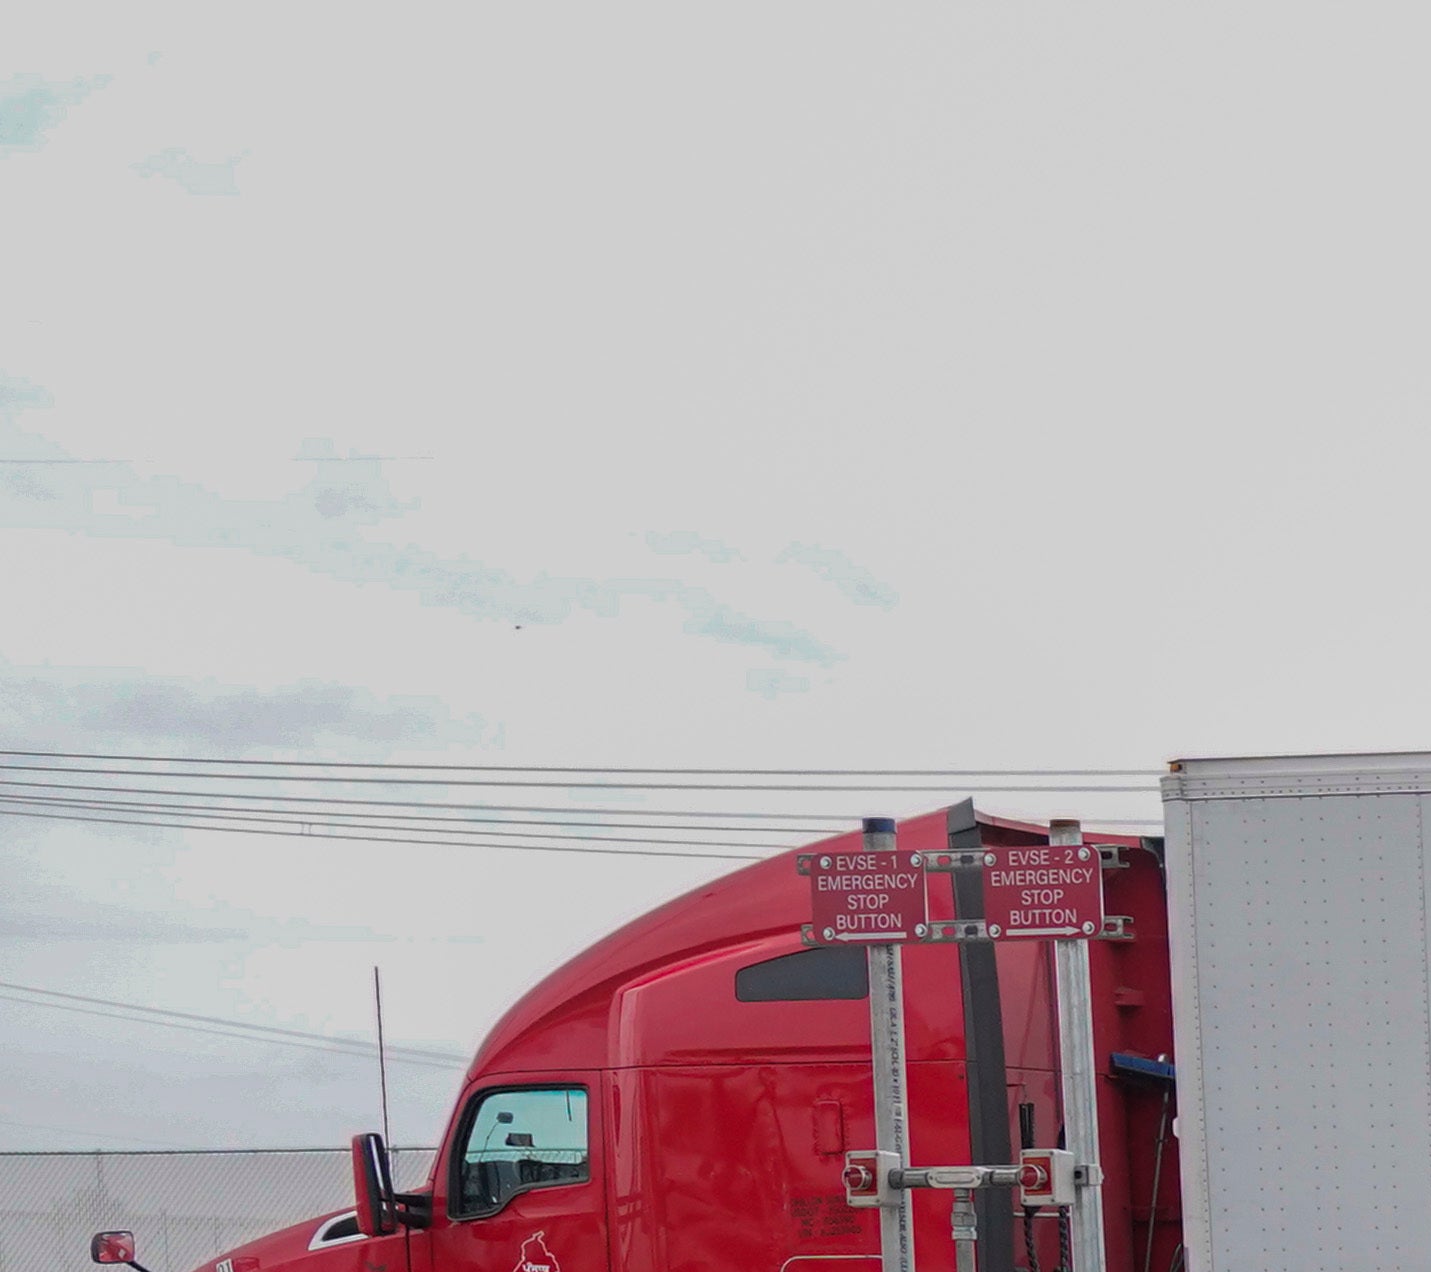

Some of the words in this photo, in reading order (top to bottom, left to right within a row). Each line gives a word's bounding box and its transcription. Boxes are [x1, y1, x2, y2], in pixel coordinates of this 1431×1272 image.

[836, 855, 878, 871] EVSE
[891, 855, 898, 869] 1
[1008, 850, 1050, 866] EVSE
[1065, 850, 1073, 864] 2
[818, 873, 918, 891] EMERGENCY
[991, 869, 1094, 887] EMERGENCY
[847, 895, 889, 910] STOP
[1021, 889, 1064, 906] STOP
[836, 913, 902, 931] BUTTON
[1009, 909, 1077, 926] BUTTON
